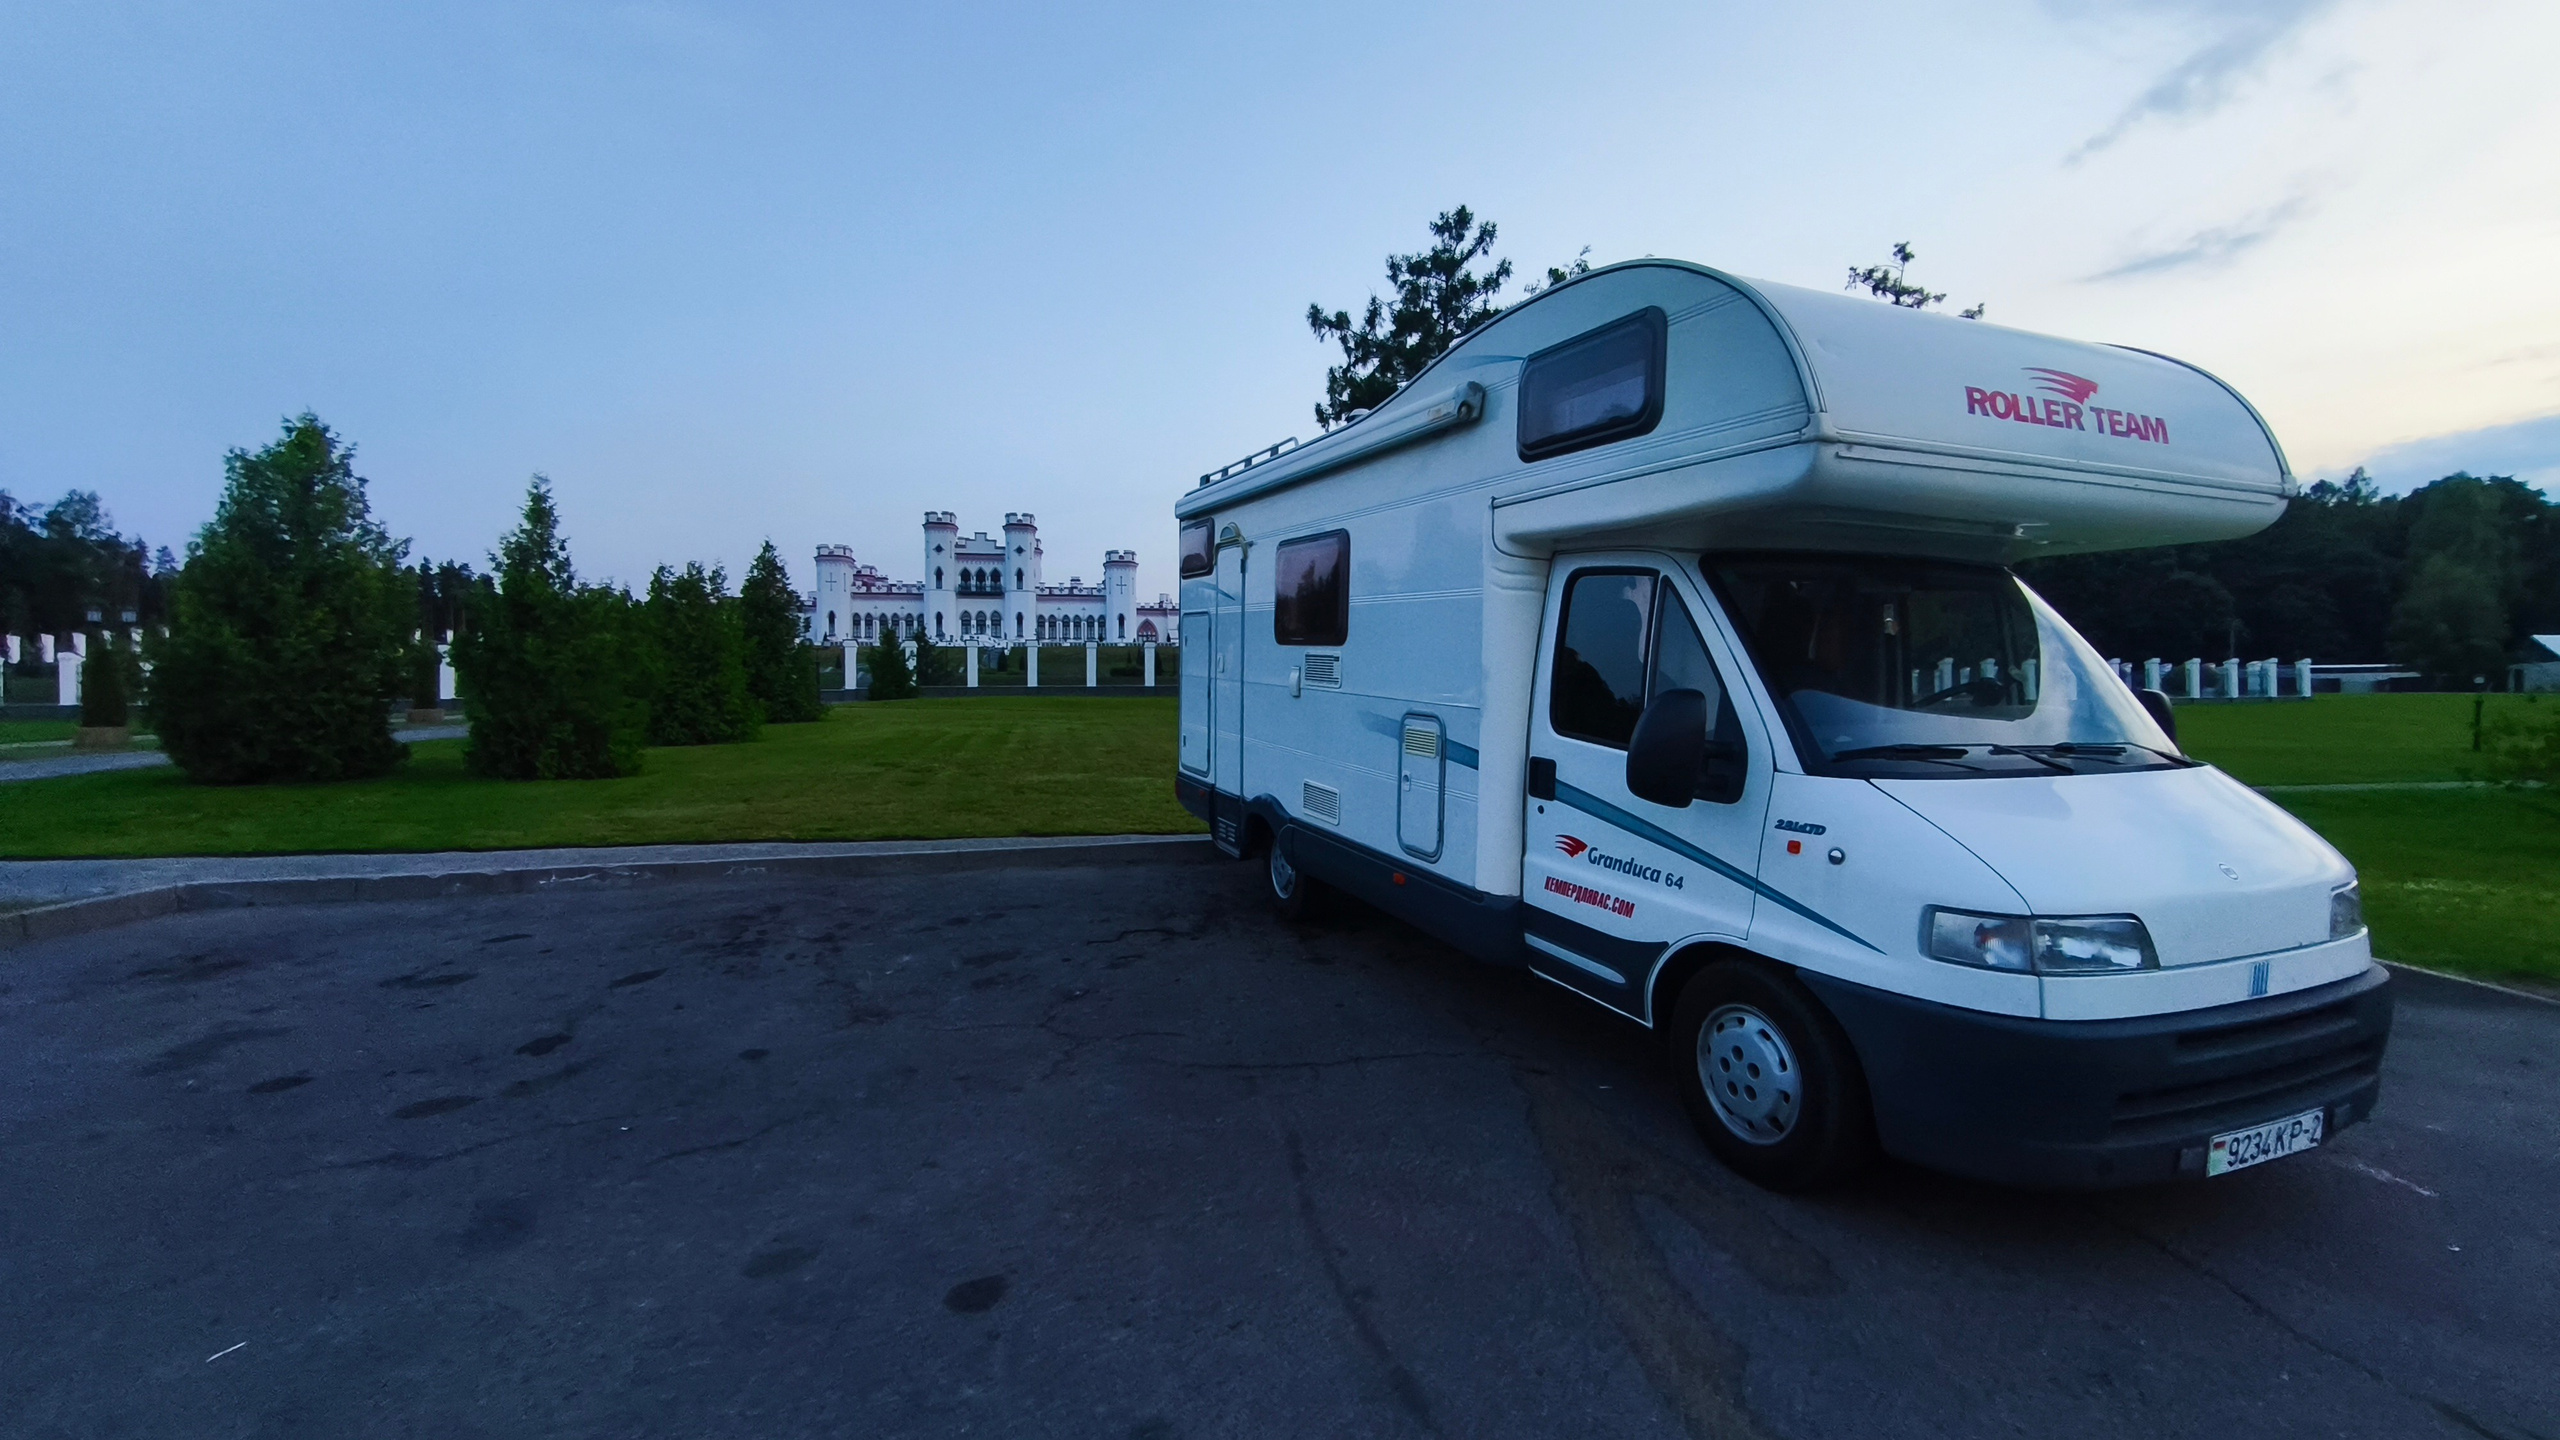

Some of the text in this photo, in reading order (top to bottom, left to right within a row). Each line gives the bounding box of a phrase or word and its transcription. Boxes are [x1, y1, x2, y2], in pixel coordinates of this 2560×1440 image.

[1964, 386, 2170, 445] ROLLER TEAM
[1587, 846, 1684, 890] Granduca 64
